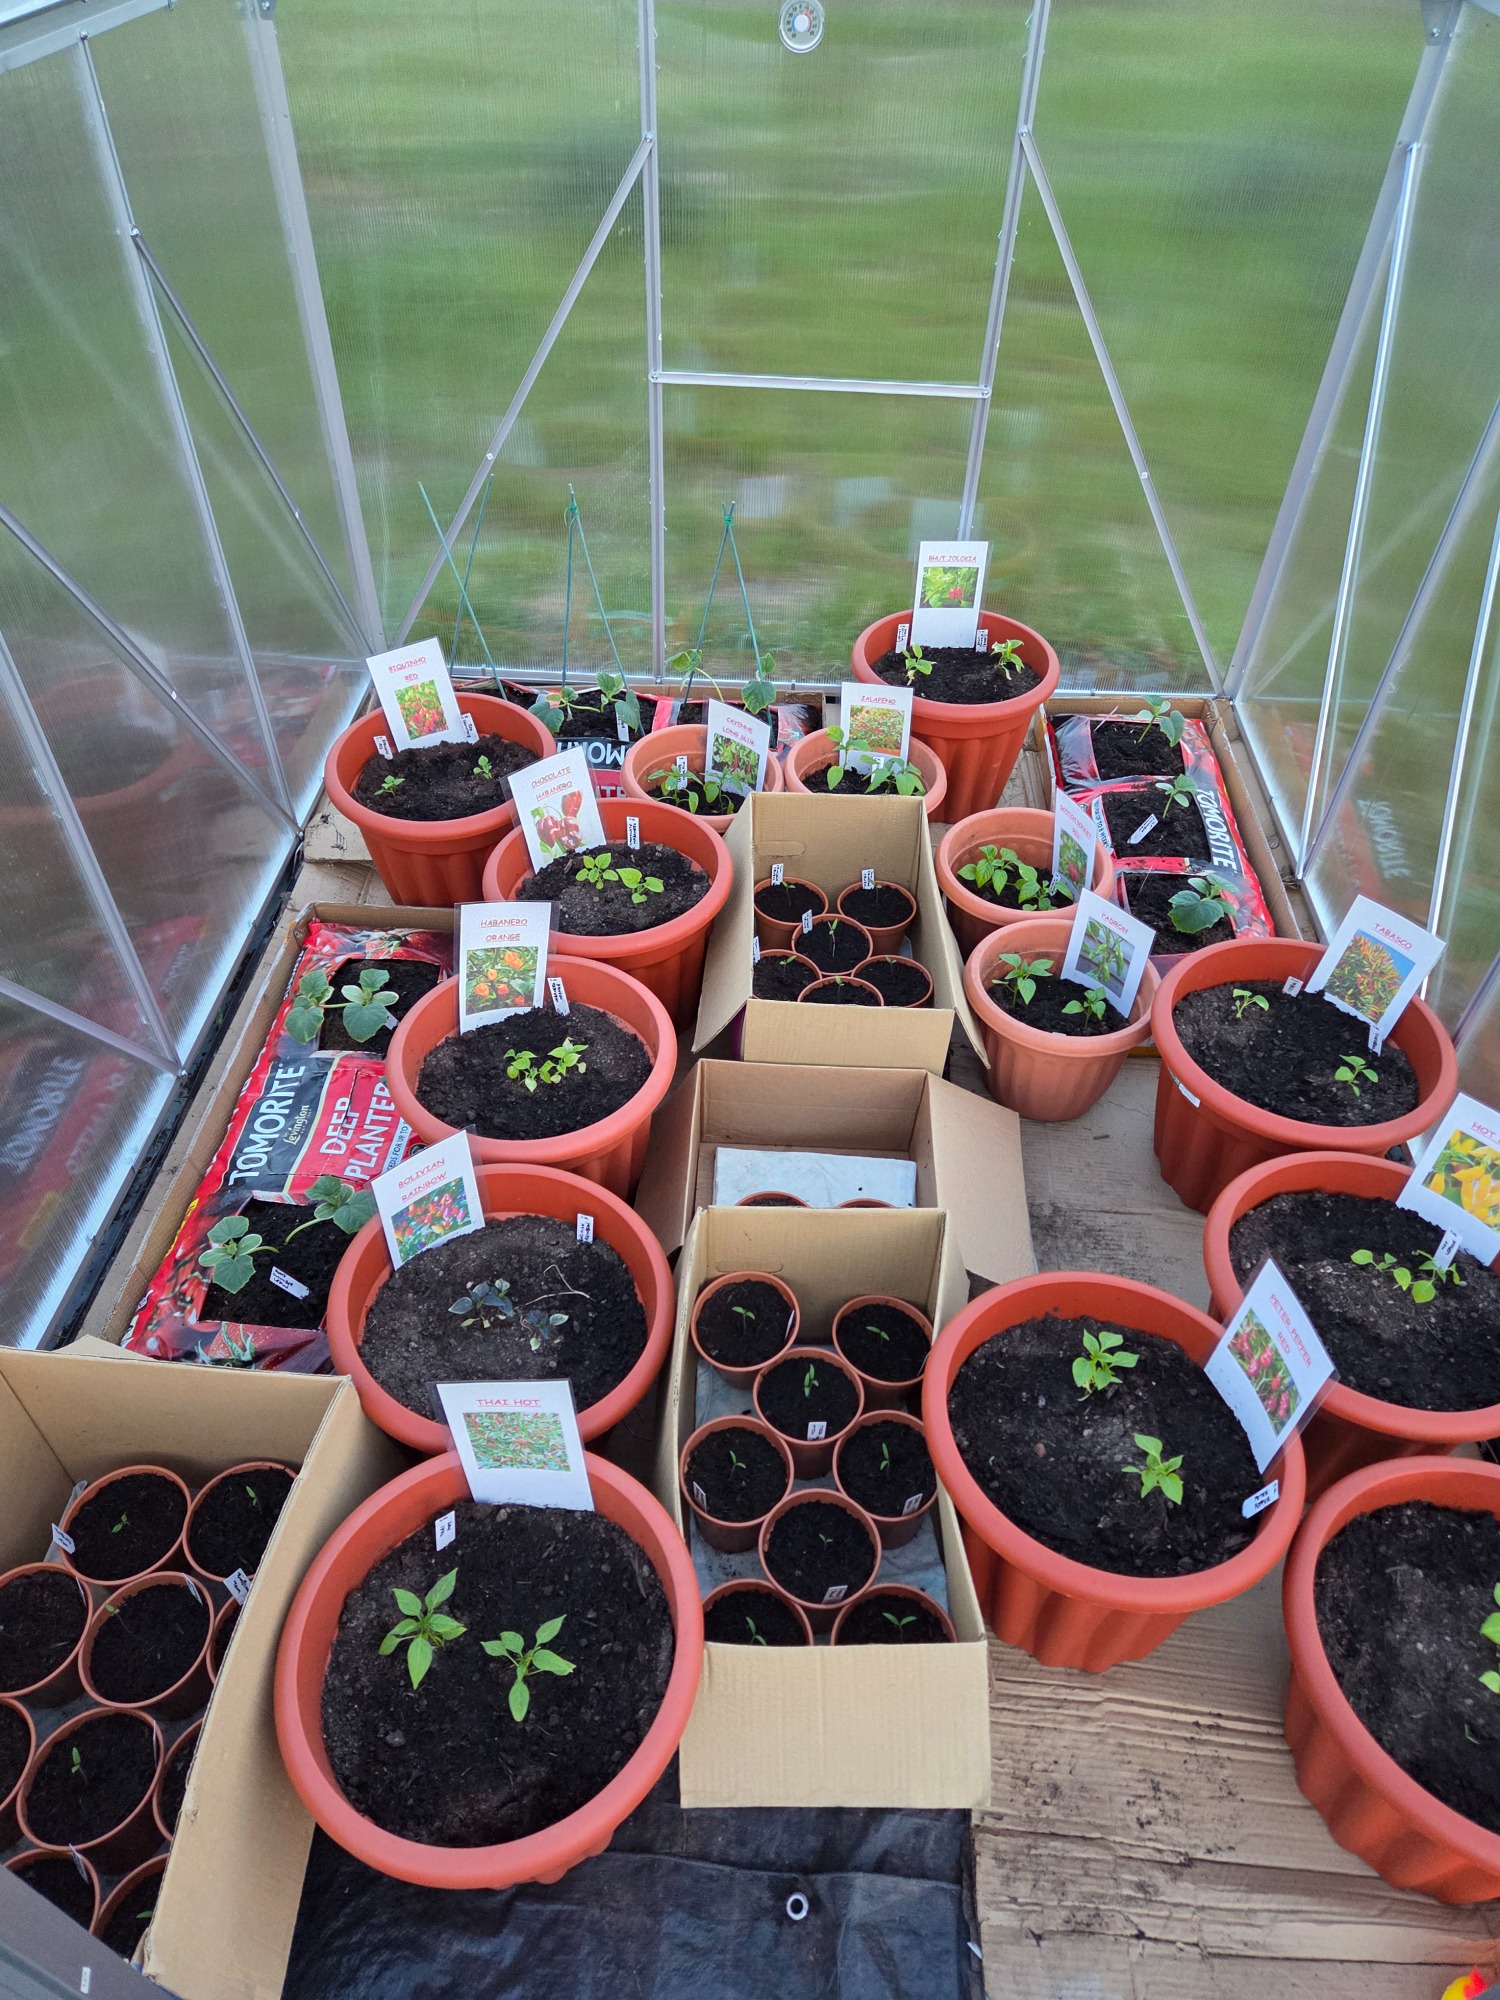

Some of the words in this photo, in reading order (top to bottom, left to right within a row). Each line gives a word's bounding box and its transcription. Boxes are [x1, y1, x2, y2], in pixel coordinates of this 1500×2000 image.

[404, 673, 418, 681] RED
[531, 767, 571, 788] CHOCOLATE
[536, 781, 573, 801] HABANERO
[1197, 789, 1237, 870] TOMORITE
[481, 919, 527, 927] HABANERO
[486, 934, 520, 942] ORANGE
[1374, 923, 1413, 949] TABASCO
[229, 1066, 305, 1185] TOMORITE
[283, 1105, 309, 1145] Levington
[320, 1097, 360, 1155] DEEP
[1472, 1122, 1496, 1138] HOT
[392, 1141, 402, 1155] FOR
[398, 1158, 445, 1189] BOLIVIAN
[402, 1172, 447, 1201] RAINBOW
[1270, 1294, 1291, 1326] PETER
[1291, 1327, 1312, 1367] PEPPER
[1277, 1332, 1290, 1354] RED
[476, 1399, 509, 1407] THAI
[513, 1399, 541, 1407] HOT
